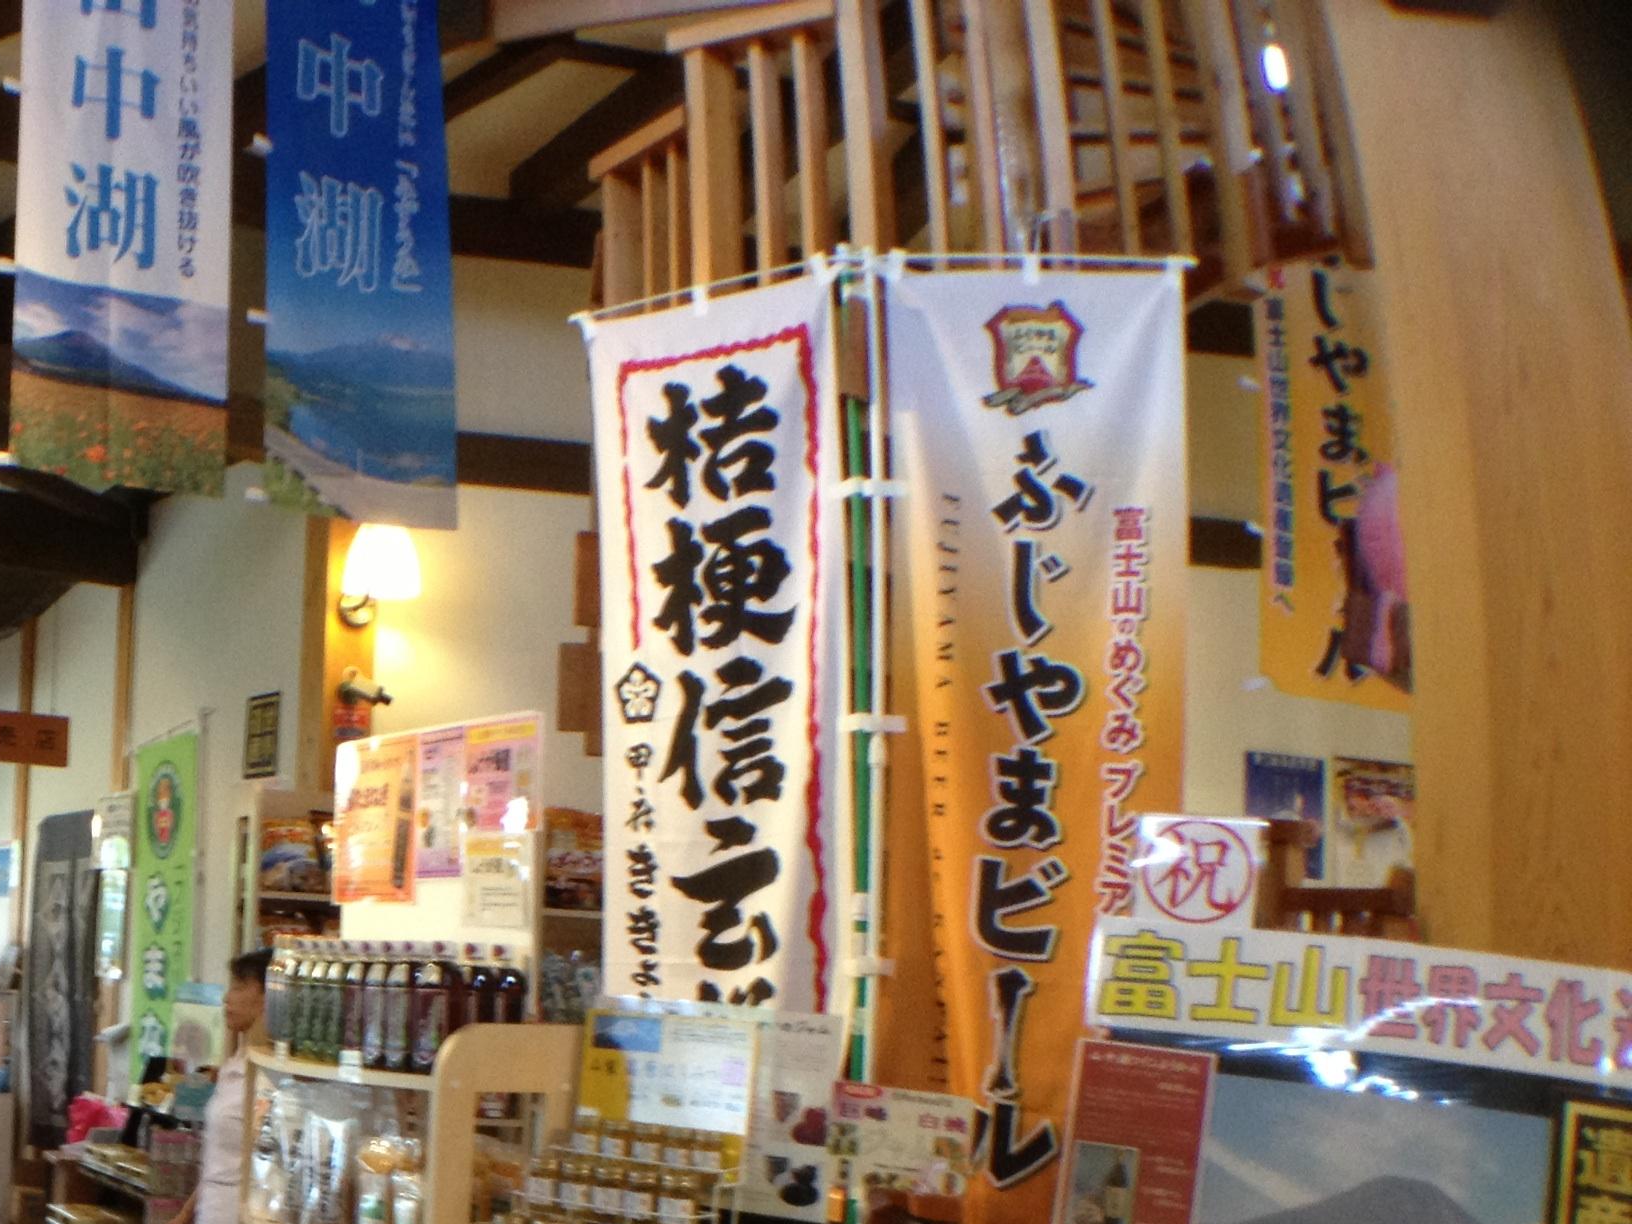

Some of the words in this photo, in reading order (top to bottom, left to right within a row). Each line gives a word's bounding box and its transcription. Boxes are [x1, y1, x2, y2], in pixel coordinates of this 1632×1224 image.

[972, 431, 1090, 1188] ふじやまビール
[1157, 837, 1241, 915] 祝
